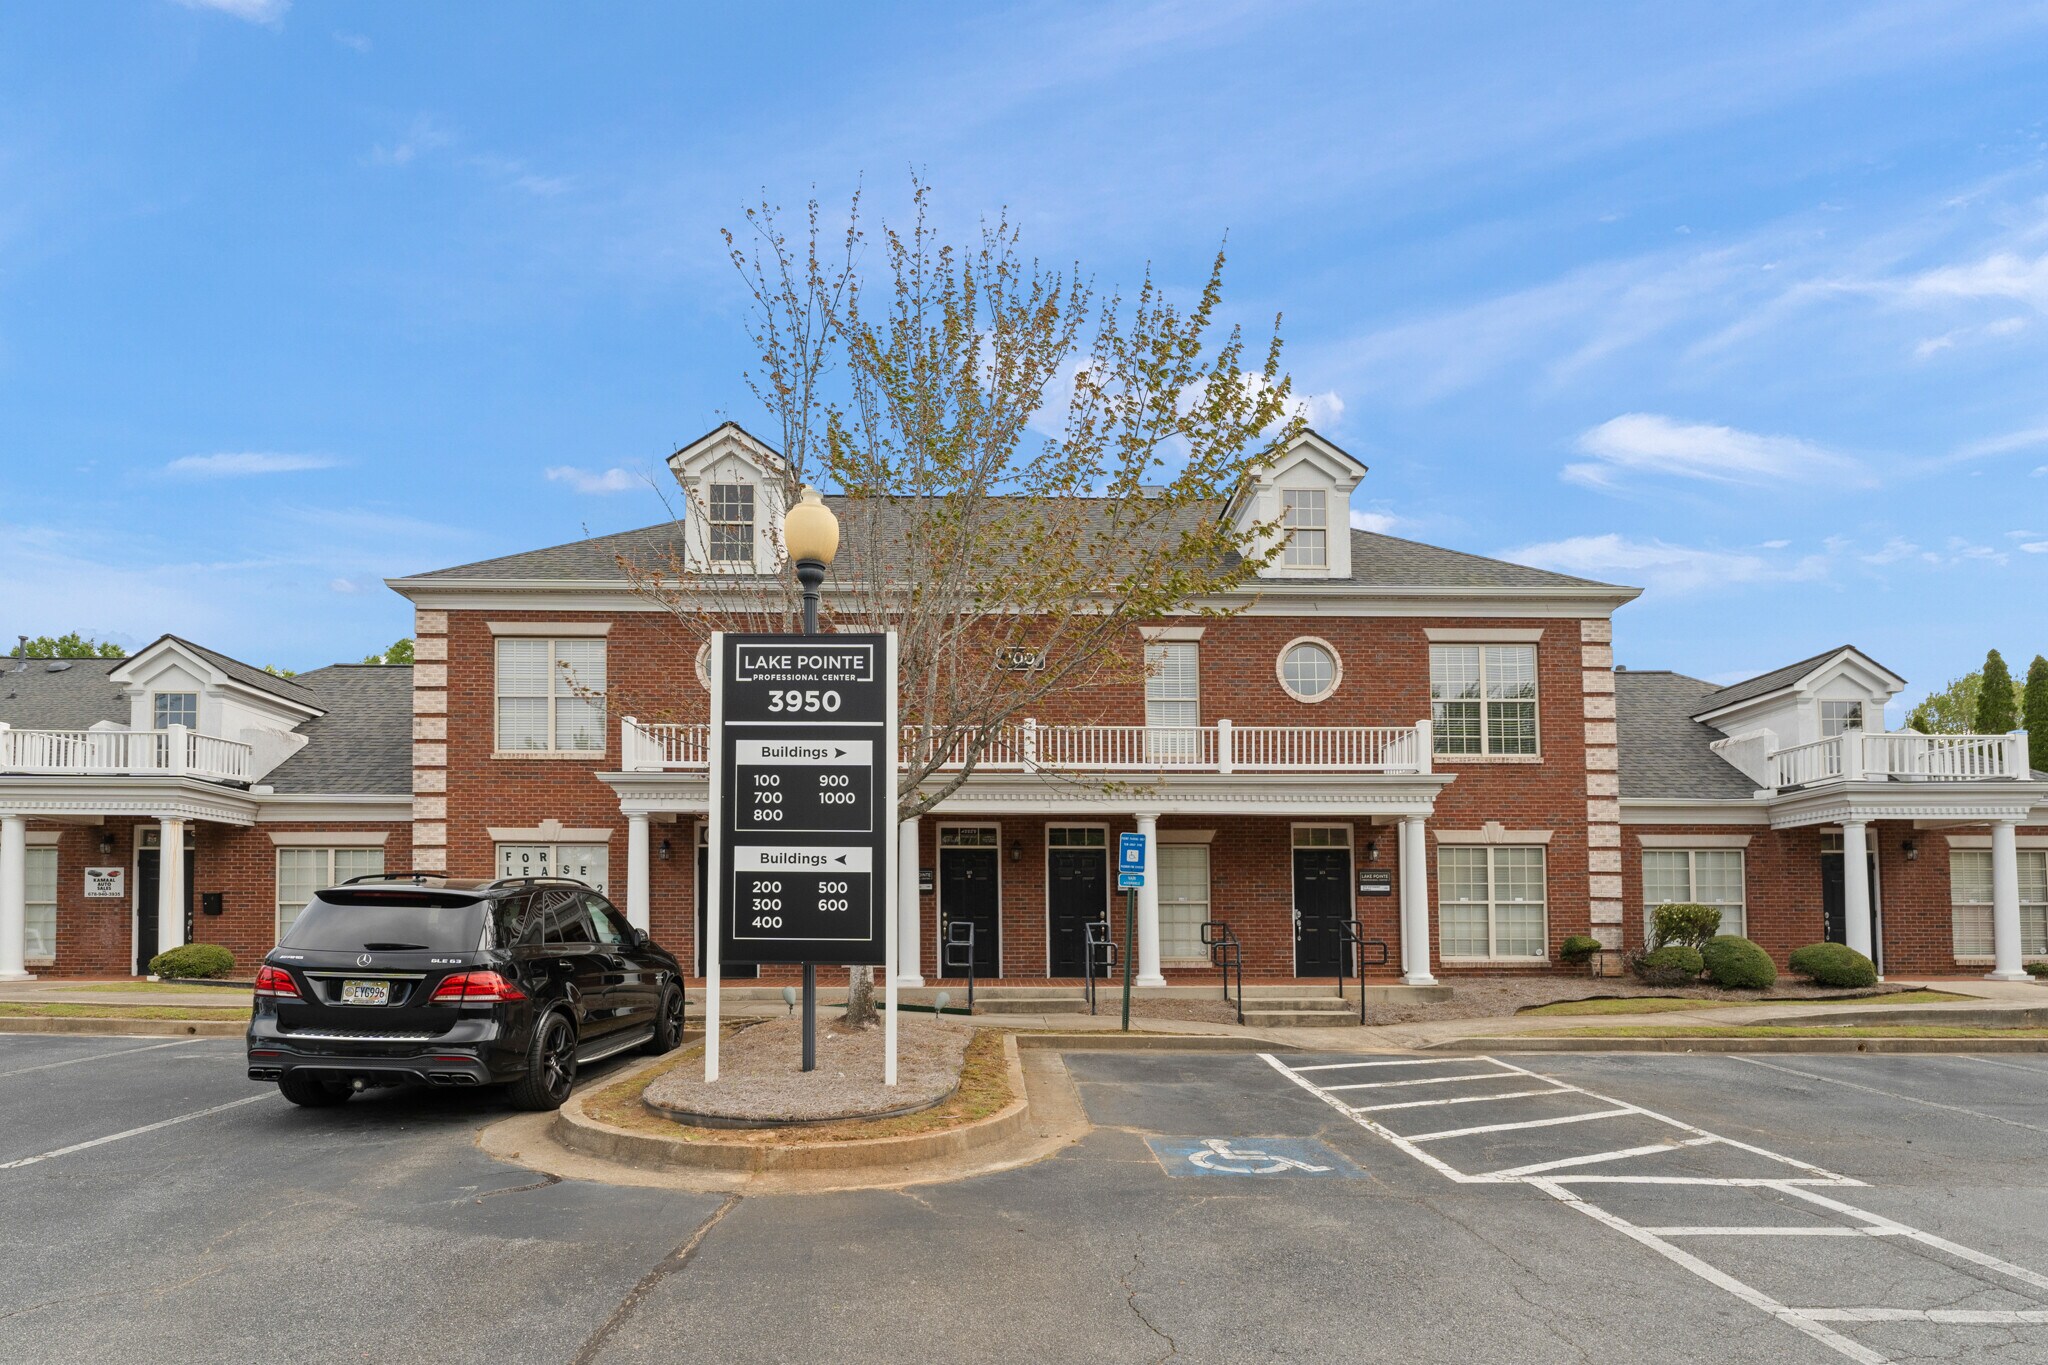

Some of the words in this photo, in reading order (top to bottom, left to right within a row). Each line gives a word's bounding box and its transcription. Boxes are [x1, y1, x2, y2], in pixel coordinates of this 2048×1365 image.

[745, 655, 791, 669] LAKE
[798, 655, 864, 669] POINTE
[768, 690, 841, 712] 3950
[761, 746, 828, 760] Buildings
[754, 775, 780, 786] 100
[819, 775, 849, 787] 900
[754, 792, 782, 804] 700
[819, 792, 855, 804] 1000
[754, 809, 783, 821] 800
[505, 851, 547, 863] FOR
[760, 852, 827, 866] Buildings
[506, 865, 587, 876] LEASE
[752, 881, 782, 893] 200
[818, 882, 848, 894] 500
[752, 899, 782, 911] 300
[818, 899, 848, 911] 600
[752, 916, 783, 928] 400
[354, 986, 385, 998] EYG996
